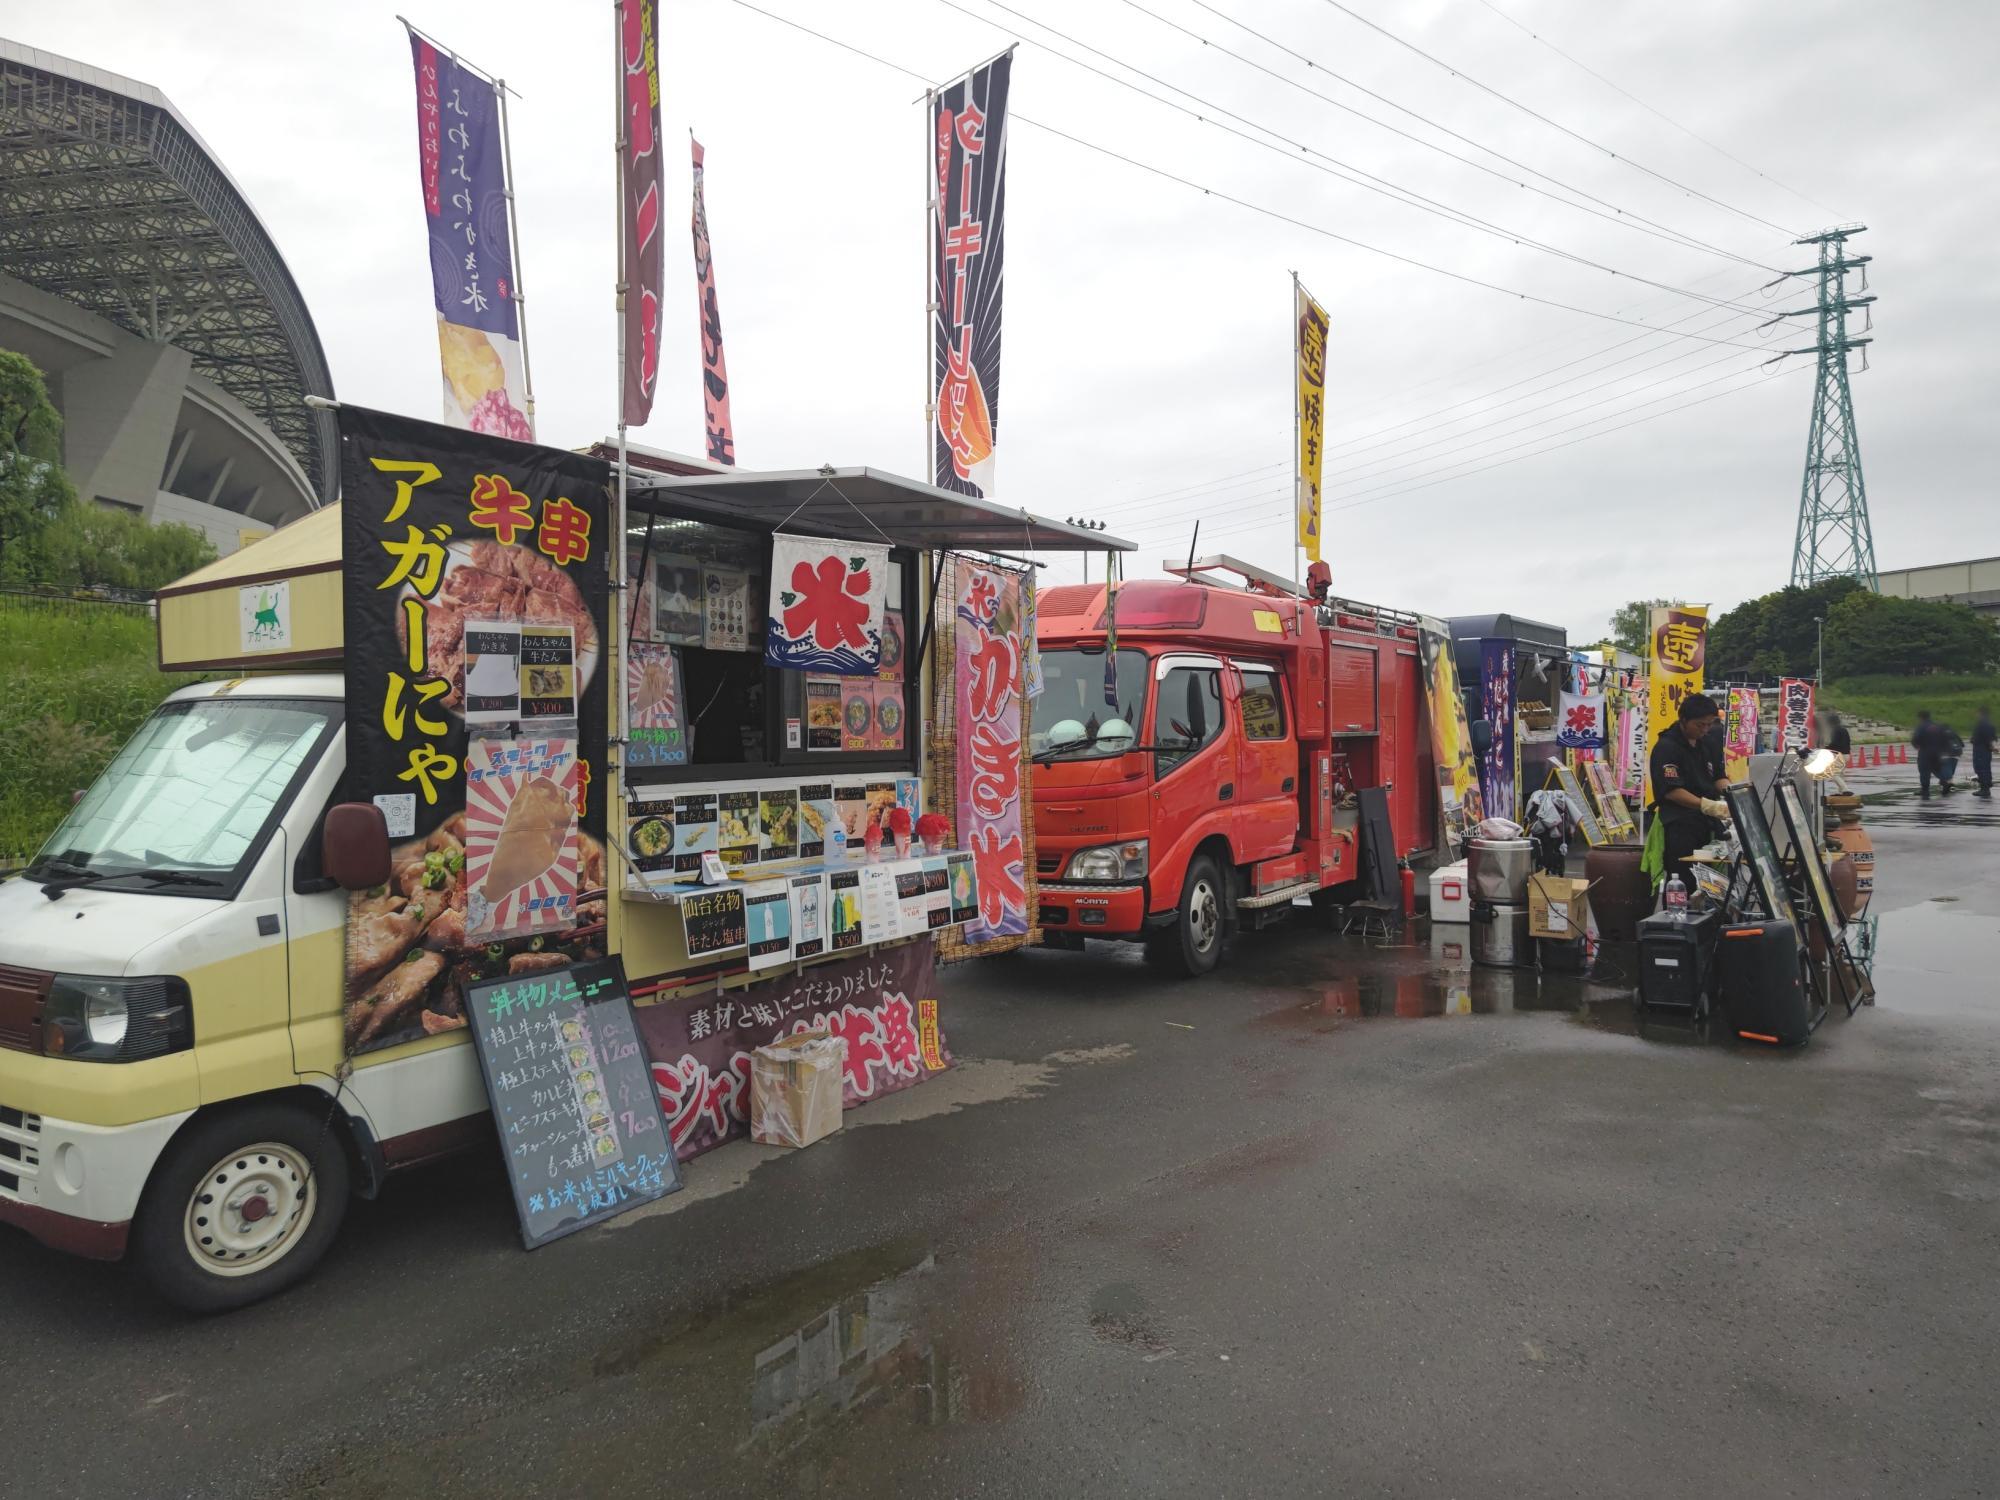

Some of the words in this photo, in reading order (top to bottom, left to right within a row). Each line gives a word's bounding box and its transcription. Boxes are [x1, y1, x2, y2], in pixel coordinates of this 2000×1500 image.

[469, 474, 591, 565] 牛串
[783, 555, 872, 650] 氷
[966, 575, 996, 619] 氷
[523, 638, 568, 648] わんちゃん
[529, 651, 561, 662] 牛たん
[531, 703, 561, 715] ¥300
[1566, 704, 1596, 731] 氷
[470, 752, 572, 783] ターキーレッグ
[491, 743, 549, 766] スモーク
[683, 892, 740, 919] 仙台名物
[1075, 897, 1109, 905] MORITA
[688, 926, 745, 952] 牛たん塩串
[488, 978, 613, 1022] 丼物メニュー
[689, 963, 894, 1041] 素材と味にこだわりました
[488, 1010, 563, 1048] 特上牛タン丼
[921, 1001, 943, 1068] 味自慢
[547, 1139, 596, 1178] もつ煮丼
